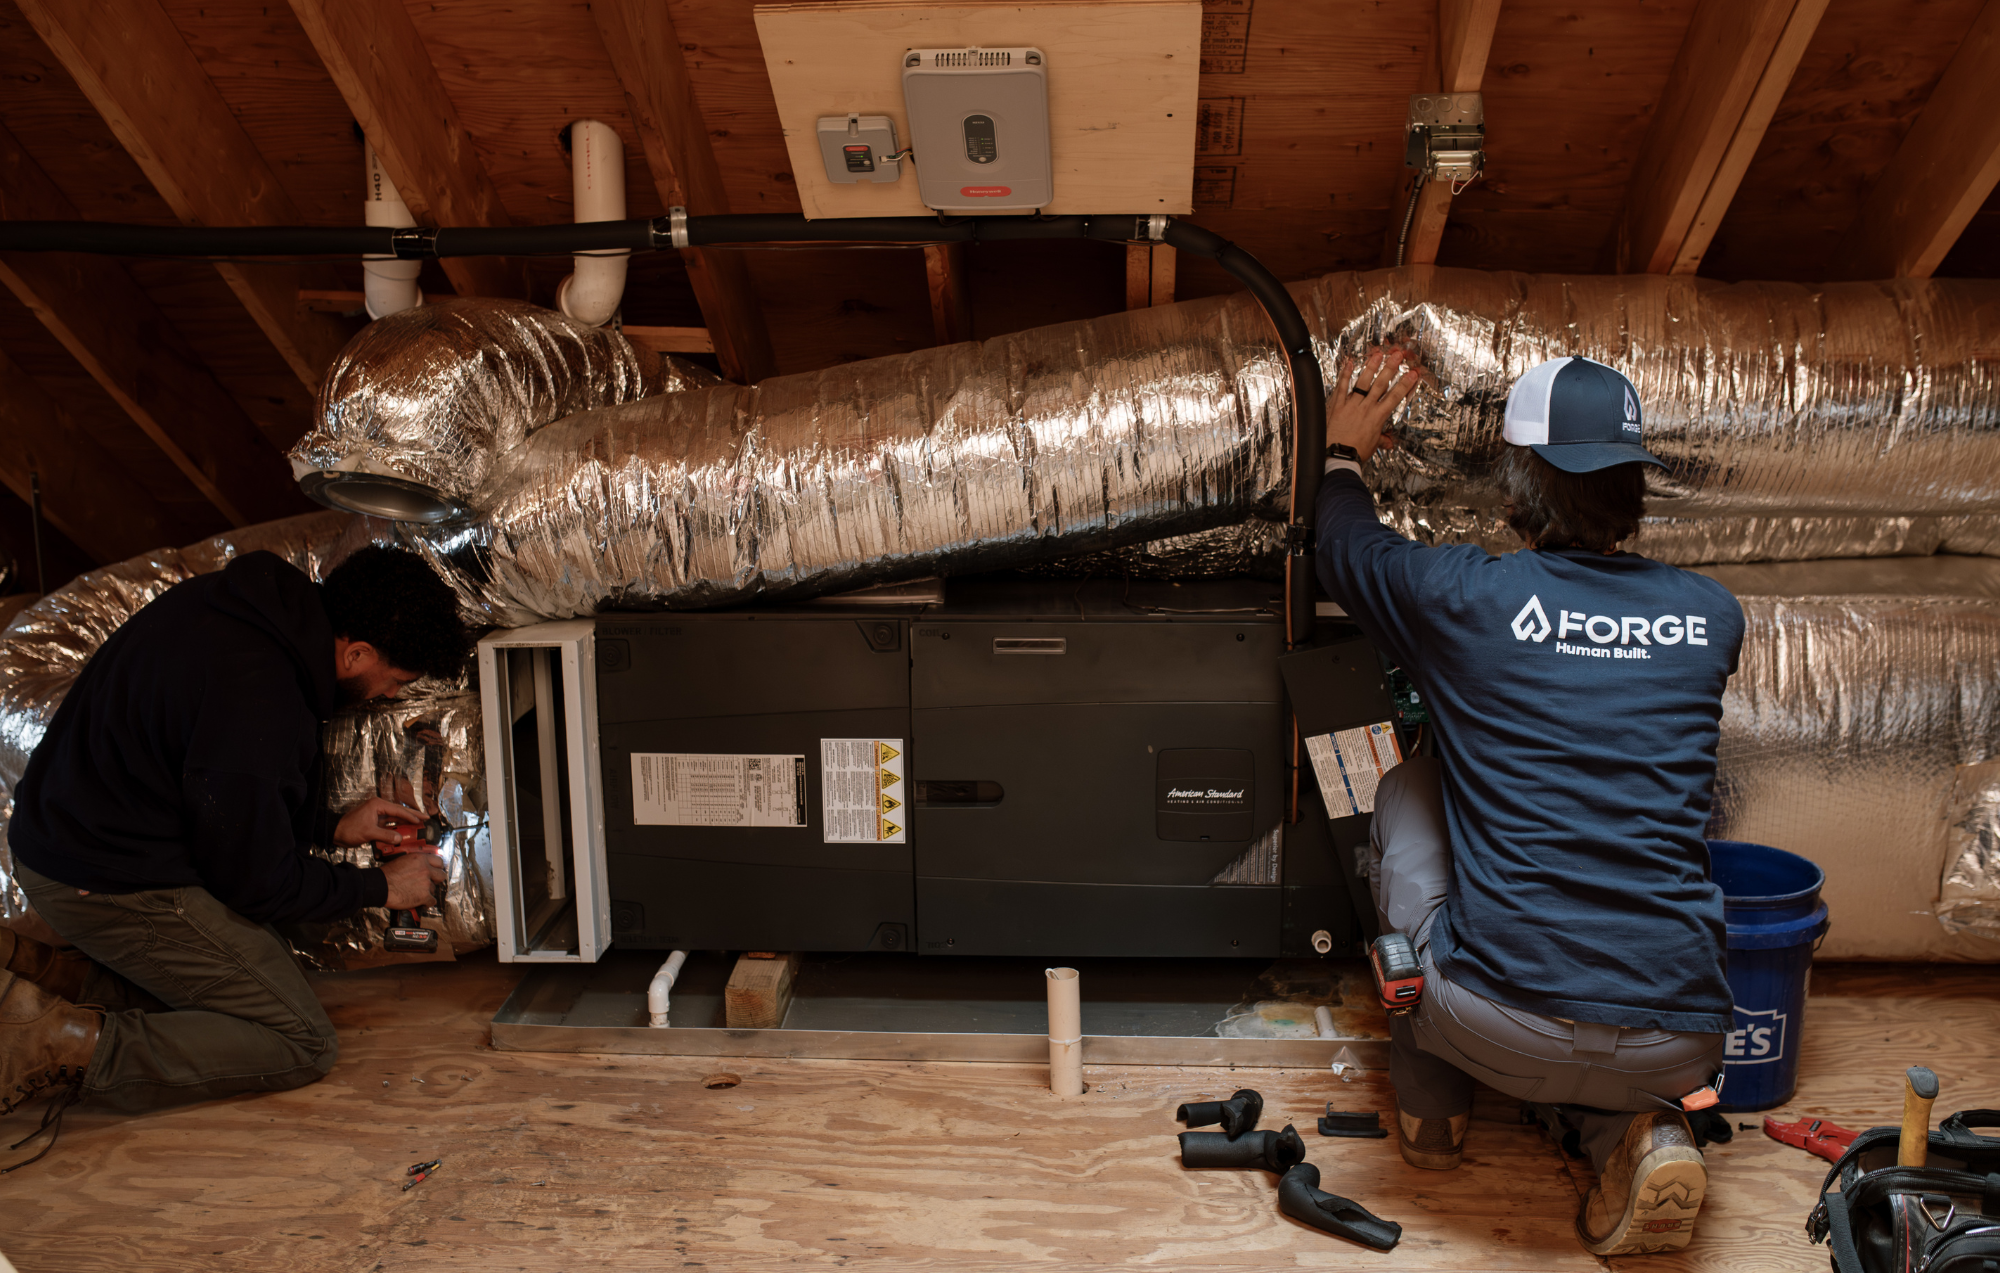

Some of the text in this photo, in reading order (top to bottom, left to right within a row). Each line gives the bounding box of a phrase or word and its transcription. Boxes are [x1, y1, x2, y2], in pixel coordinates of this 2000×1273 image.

[1622, 422, 1641, 433] FORGE
[602, 627, 641, 636] BLOWER
[649, 627, 682, 636] FILTER
[918, 628, 942, 637] COIL
[1558, 609, 1709, 646] FORGE
[1556, 642, 1652, 659] Human Built.
[1331, 736, 1339, 751] NOTICE
[1167, 788, 1245, 798] American Standard
[1272, 854, 1278, 862] by
[1270, 863, 1278, 883] Design
[1725, 1024, 1772, 1056] E'S
